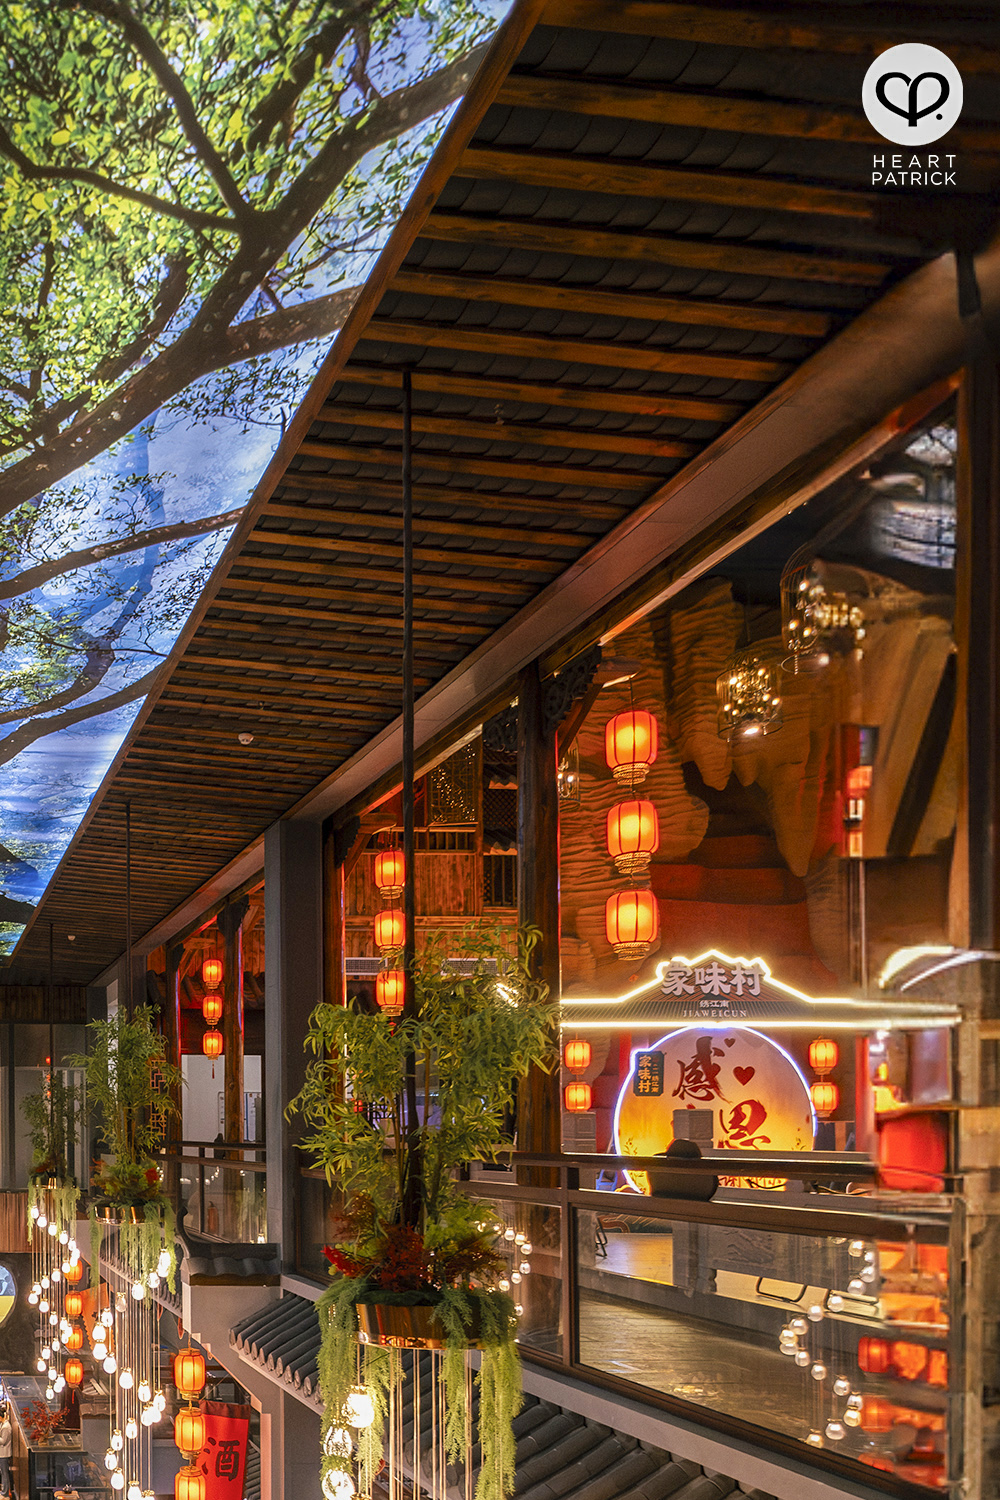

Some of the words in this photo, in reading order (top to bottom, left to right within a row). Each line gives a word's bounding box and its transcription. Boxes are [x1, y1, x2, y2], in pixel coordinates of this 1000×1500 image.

[661, 961, 766, 997] 家味村
[683, 1010, 747, 1018] JIAWEICUN
[637, 1054, 652, 1093] 家味村
[201, 1437, 240, 1481] 酒
